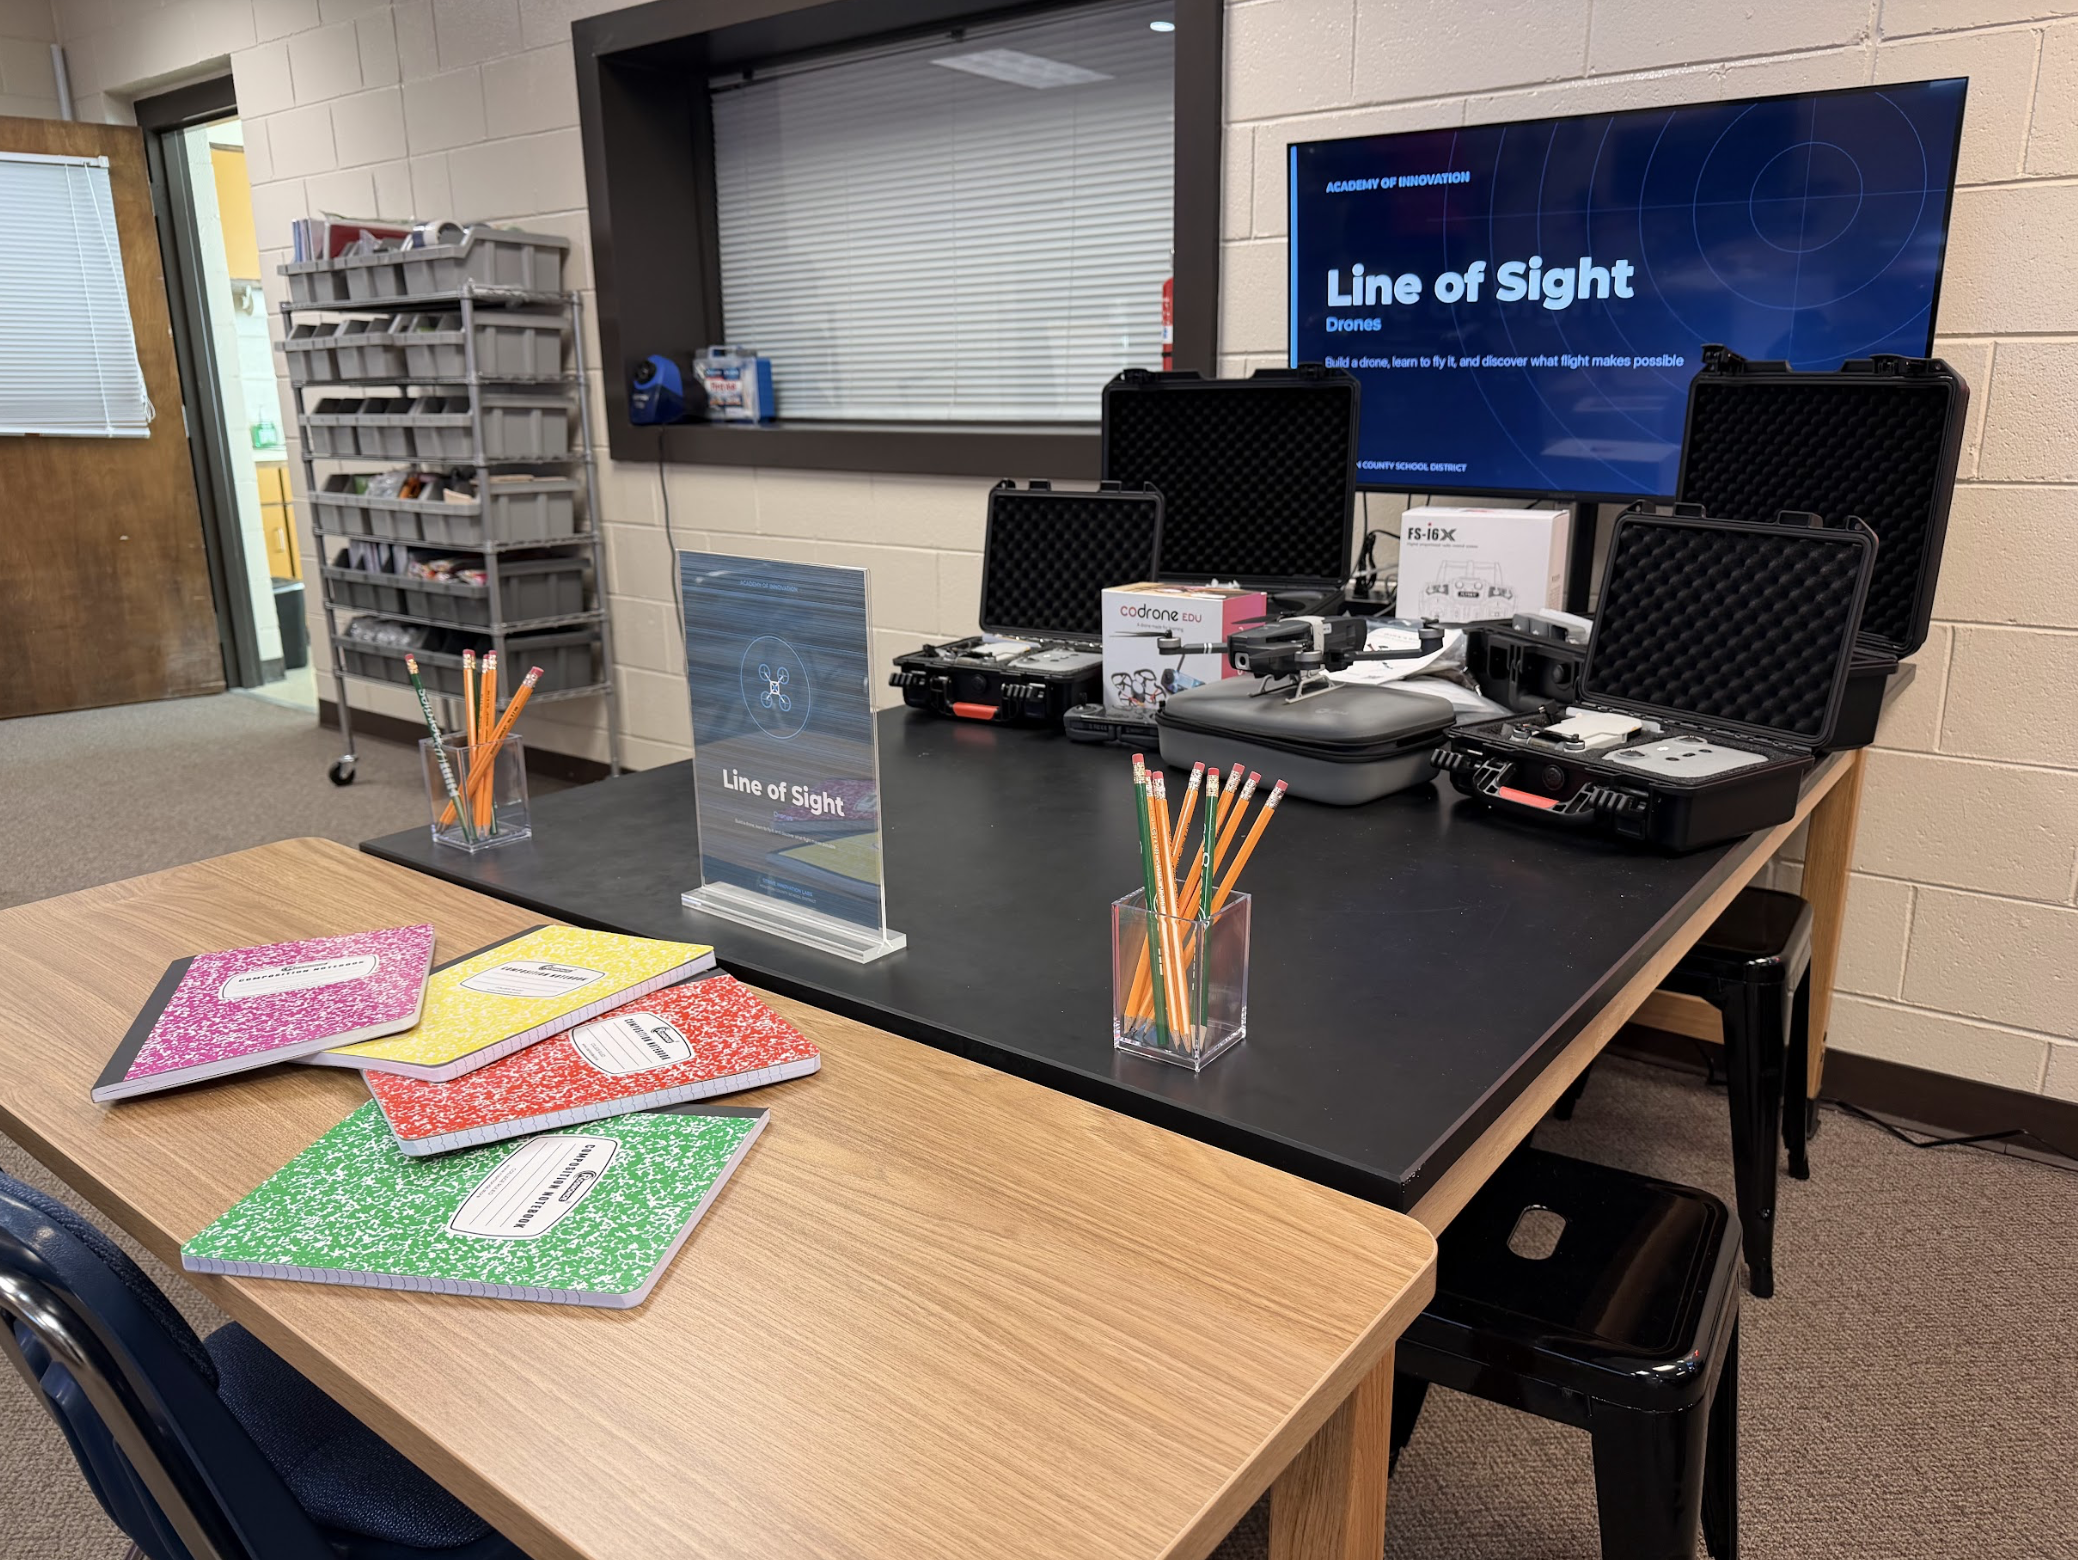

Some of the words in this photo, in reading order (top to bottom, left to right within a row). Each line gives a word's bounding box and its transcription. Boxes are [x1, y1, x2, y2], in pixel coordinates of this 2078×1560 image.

[1326, 178, 1379, 193] ACADEMY
[1380, 176, 1397, 189] OF
[1398, 171, 1471, 188] INNOVATION
[1327, 263, 1423, 307] Line
[1434, 260, 1487, 304] of
[1496, 255, 1635, 311] Sight
[1325, 316, 1382, 333] Drones
[1325, 356, 1350, 368] Build
[1351, 358, 1358, 368] a
[1359, 355, 1391, 369] drone,
[1392, 355, 1418, 368] learn
[1420, 356, 1431, 368] to
[1432, 355, 1446, 370] fly
[1447, 355, 1457, 369] it,
[1459, 355, 1480, 368] and
[1482, 354, 1528, 368] discover
[1530, 354, 1558, 367] what
[1561, 354, 1590, 369] flight
[1592, 354, 1631, 367] makes
[1633, 354, 1685, 369] possible
[1362, 460, 1395, 470] COUNTY
[1395, 461, 1429, 471] SCHOOL
[1429, 462, 1467, 472] DISTRICT
[1120, 603, 1179, 622] codrone
[1182, 612, 1202, 623] EDU
[722, 768, 762, 796] Line
[767, 781, 787, 802] of
[791, 785, 845, 817] Sight
[238, 968, 309, 982] COMPOSITION
[313, 960, 364, 971] NOTEBOOK
[500, 966, 549, 977] COMPOSITION
[549, 973, 589, 982] NOTEBOOK
[624, 1018, 652, 1042] COMPOSITION
[646, 1042, 671, 1060] NOTEBOOK
[548, 1144, 596, 1192] COMPOSITION
[513, 1192, 555, 1229] NOTEBOOK
